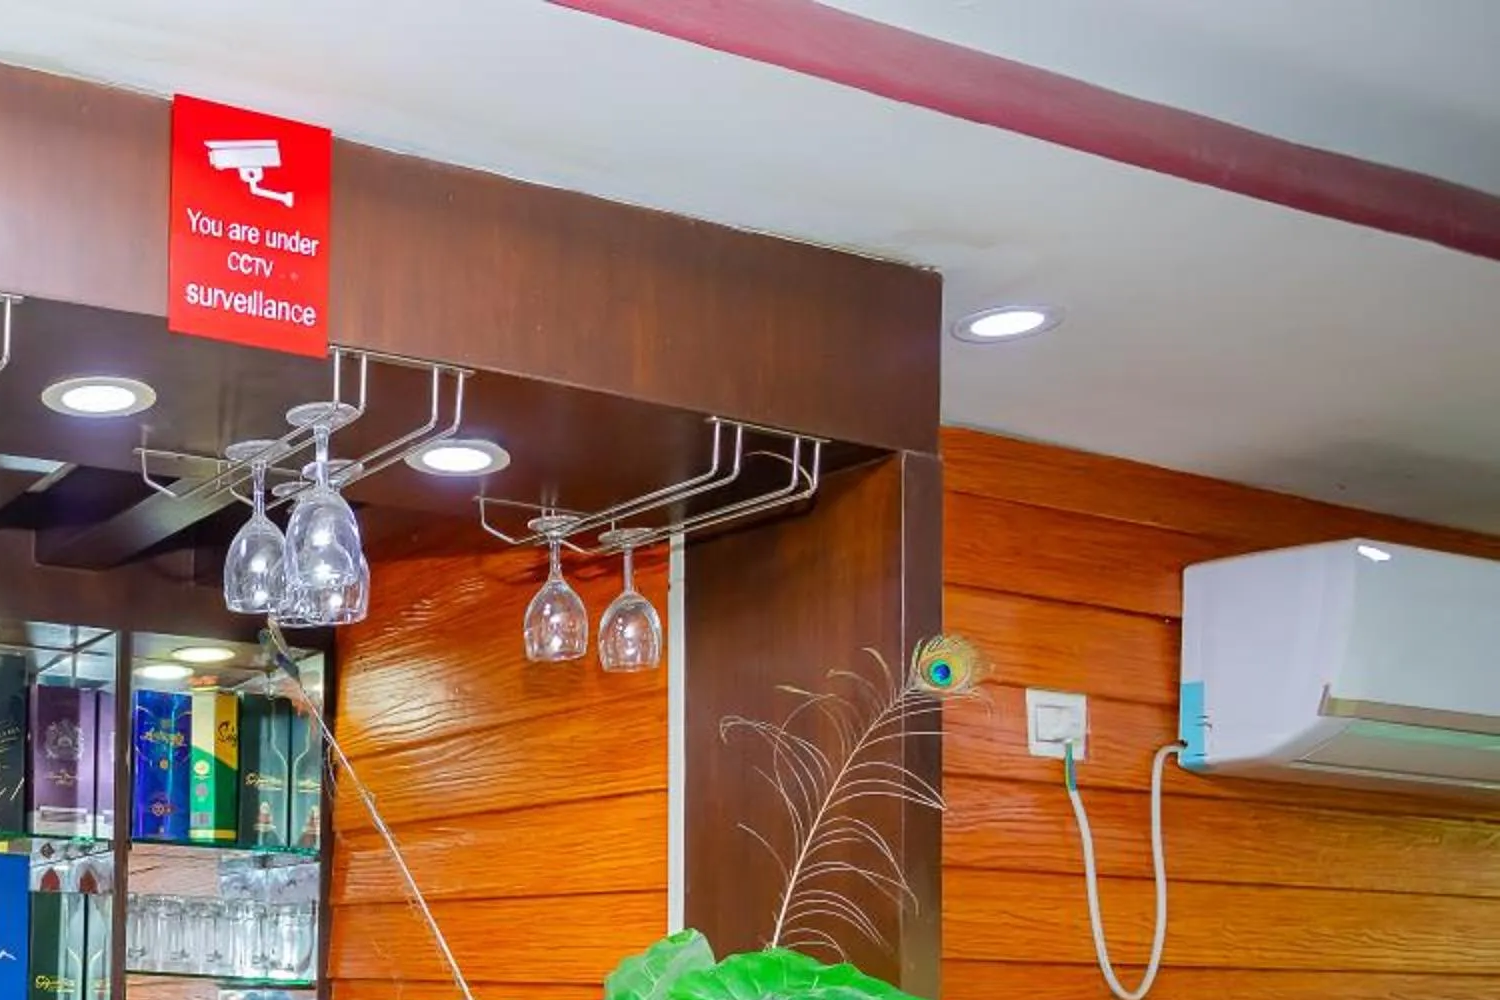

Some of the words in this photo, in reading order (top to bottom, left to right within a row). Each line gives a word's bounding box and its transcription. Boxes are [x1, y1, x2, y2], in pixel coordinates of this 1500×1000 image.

[187, 207, 222, 238] You
[228, 222, 260, 245] are
[265, 228, 319, 257] under
[227, 251, 273, 278] CCTV
[186, 282, 316, 327] surveillance
